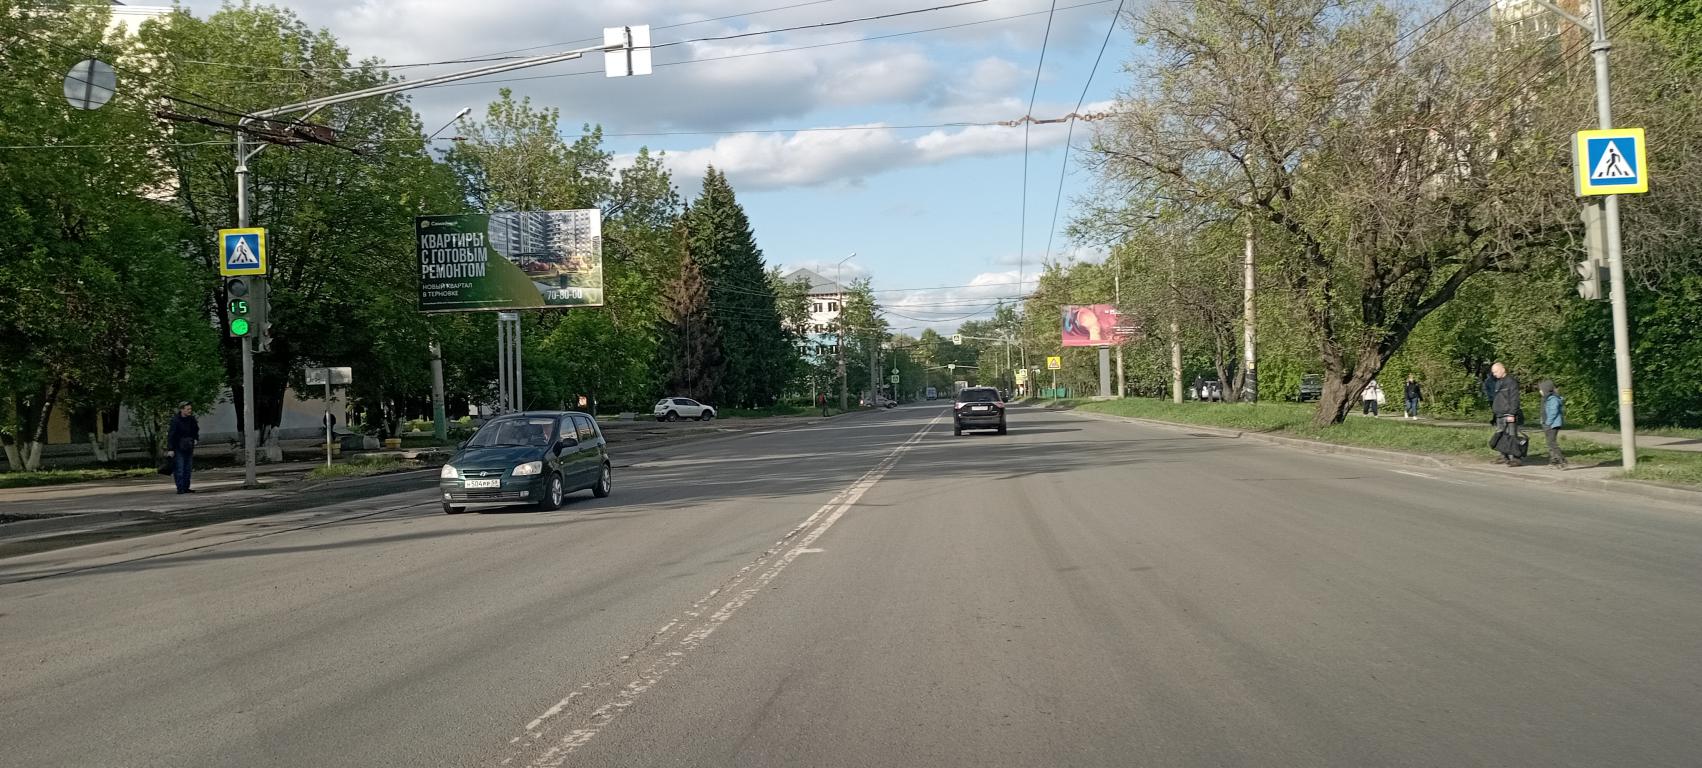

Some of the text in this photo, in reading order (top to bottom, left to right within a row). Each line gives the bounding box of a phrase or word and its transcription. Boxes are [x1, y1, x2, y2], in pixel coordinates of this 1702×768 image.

[421, 232, 484, 249] КВАРТИРЫ
[421, 247, 488, 264] С ГОТОВЫМ
[422, 262, 486, 279] РЕМОНТОМ
[231, 301, 247, 313] 15
